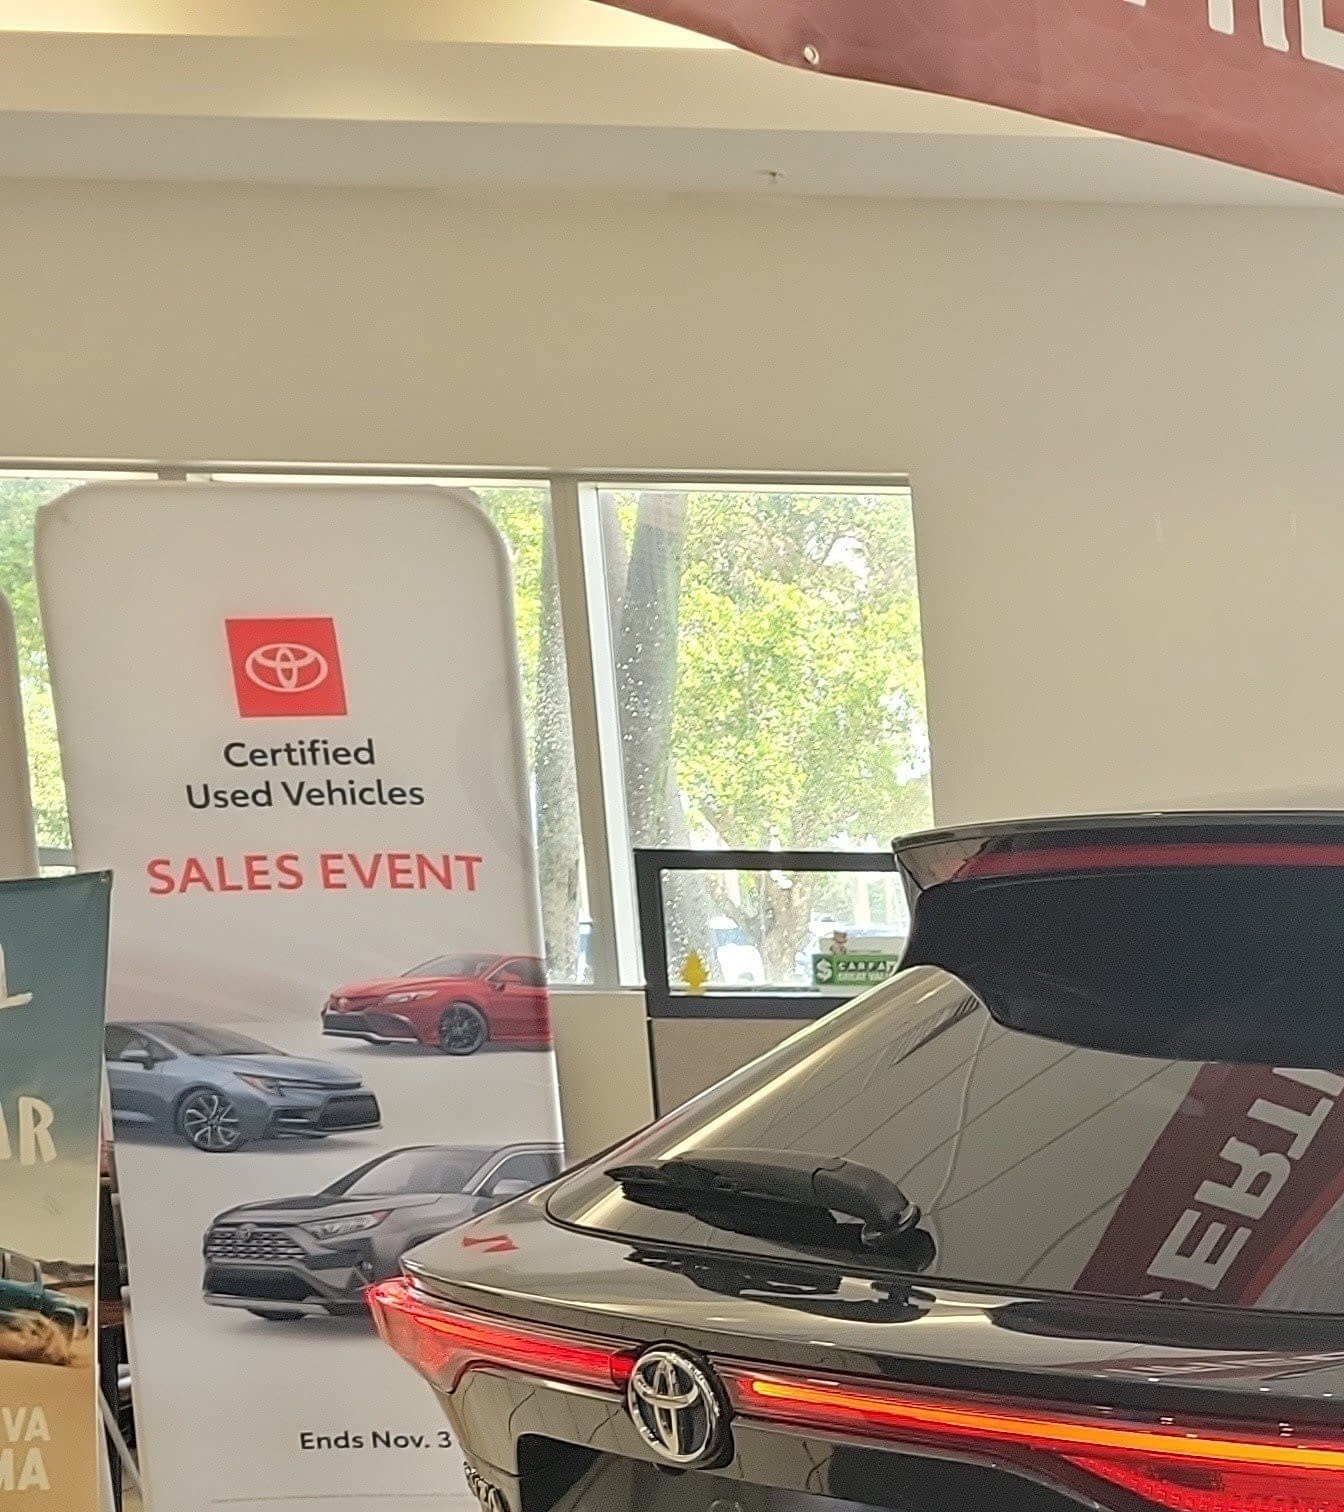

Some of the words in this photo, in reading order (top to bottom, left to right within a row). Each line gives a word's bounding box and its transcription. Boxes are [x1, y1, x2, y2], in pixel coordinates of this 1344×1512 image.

[223, 738, 376, 767] Certified
[185, 780, 274, 809] Used
[281, 778, 425, 806] Vehicles
[146, 853, 304, 895] SALES
[319, 852, 483, 892] EVENT
[300, 1431, 364, 1450] Ends
[372, 1431, 430, 1449] Nov.
[438, 1431, 452, 1448] 3
